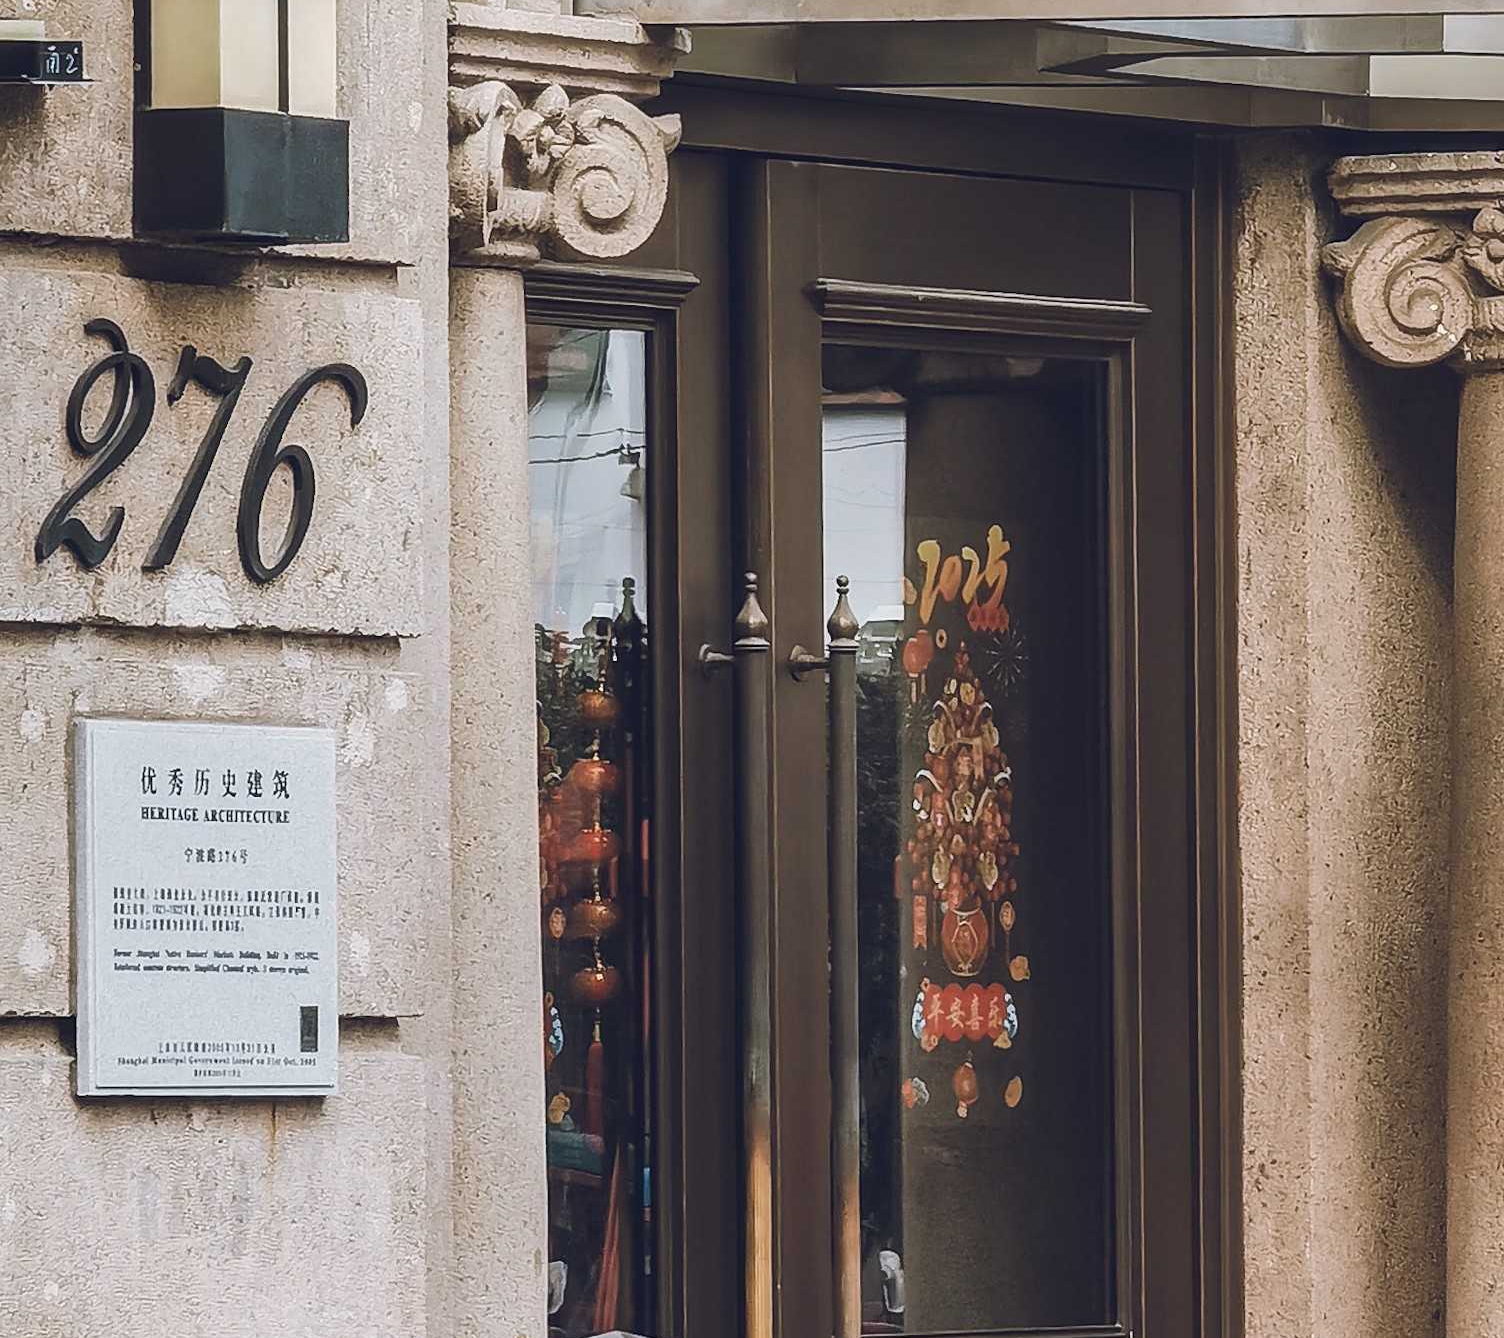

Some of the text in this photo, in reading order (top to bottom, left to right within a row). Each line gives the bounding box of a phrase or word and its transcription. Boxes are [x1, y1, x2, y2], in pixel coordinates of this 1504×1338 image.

[35, 318, 368, 584] 276
[917, 524, 1011, 625] 2025
[140, 766, 291, 800] 优秀历史建筑
[140, 806, 291, 824] HERITAGE ARCHITECTURE
